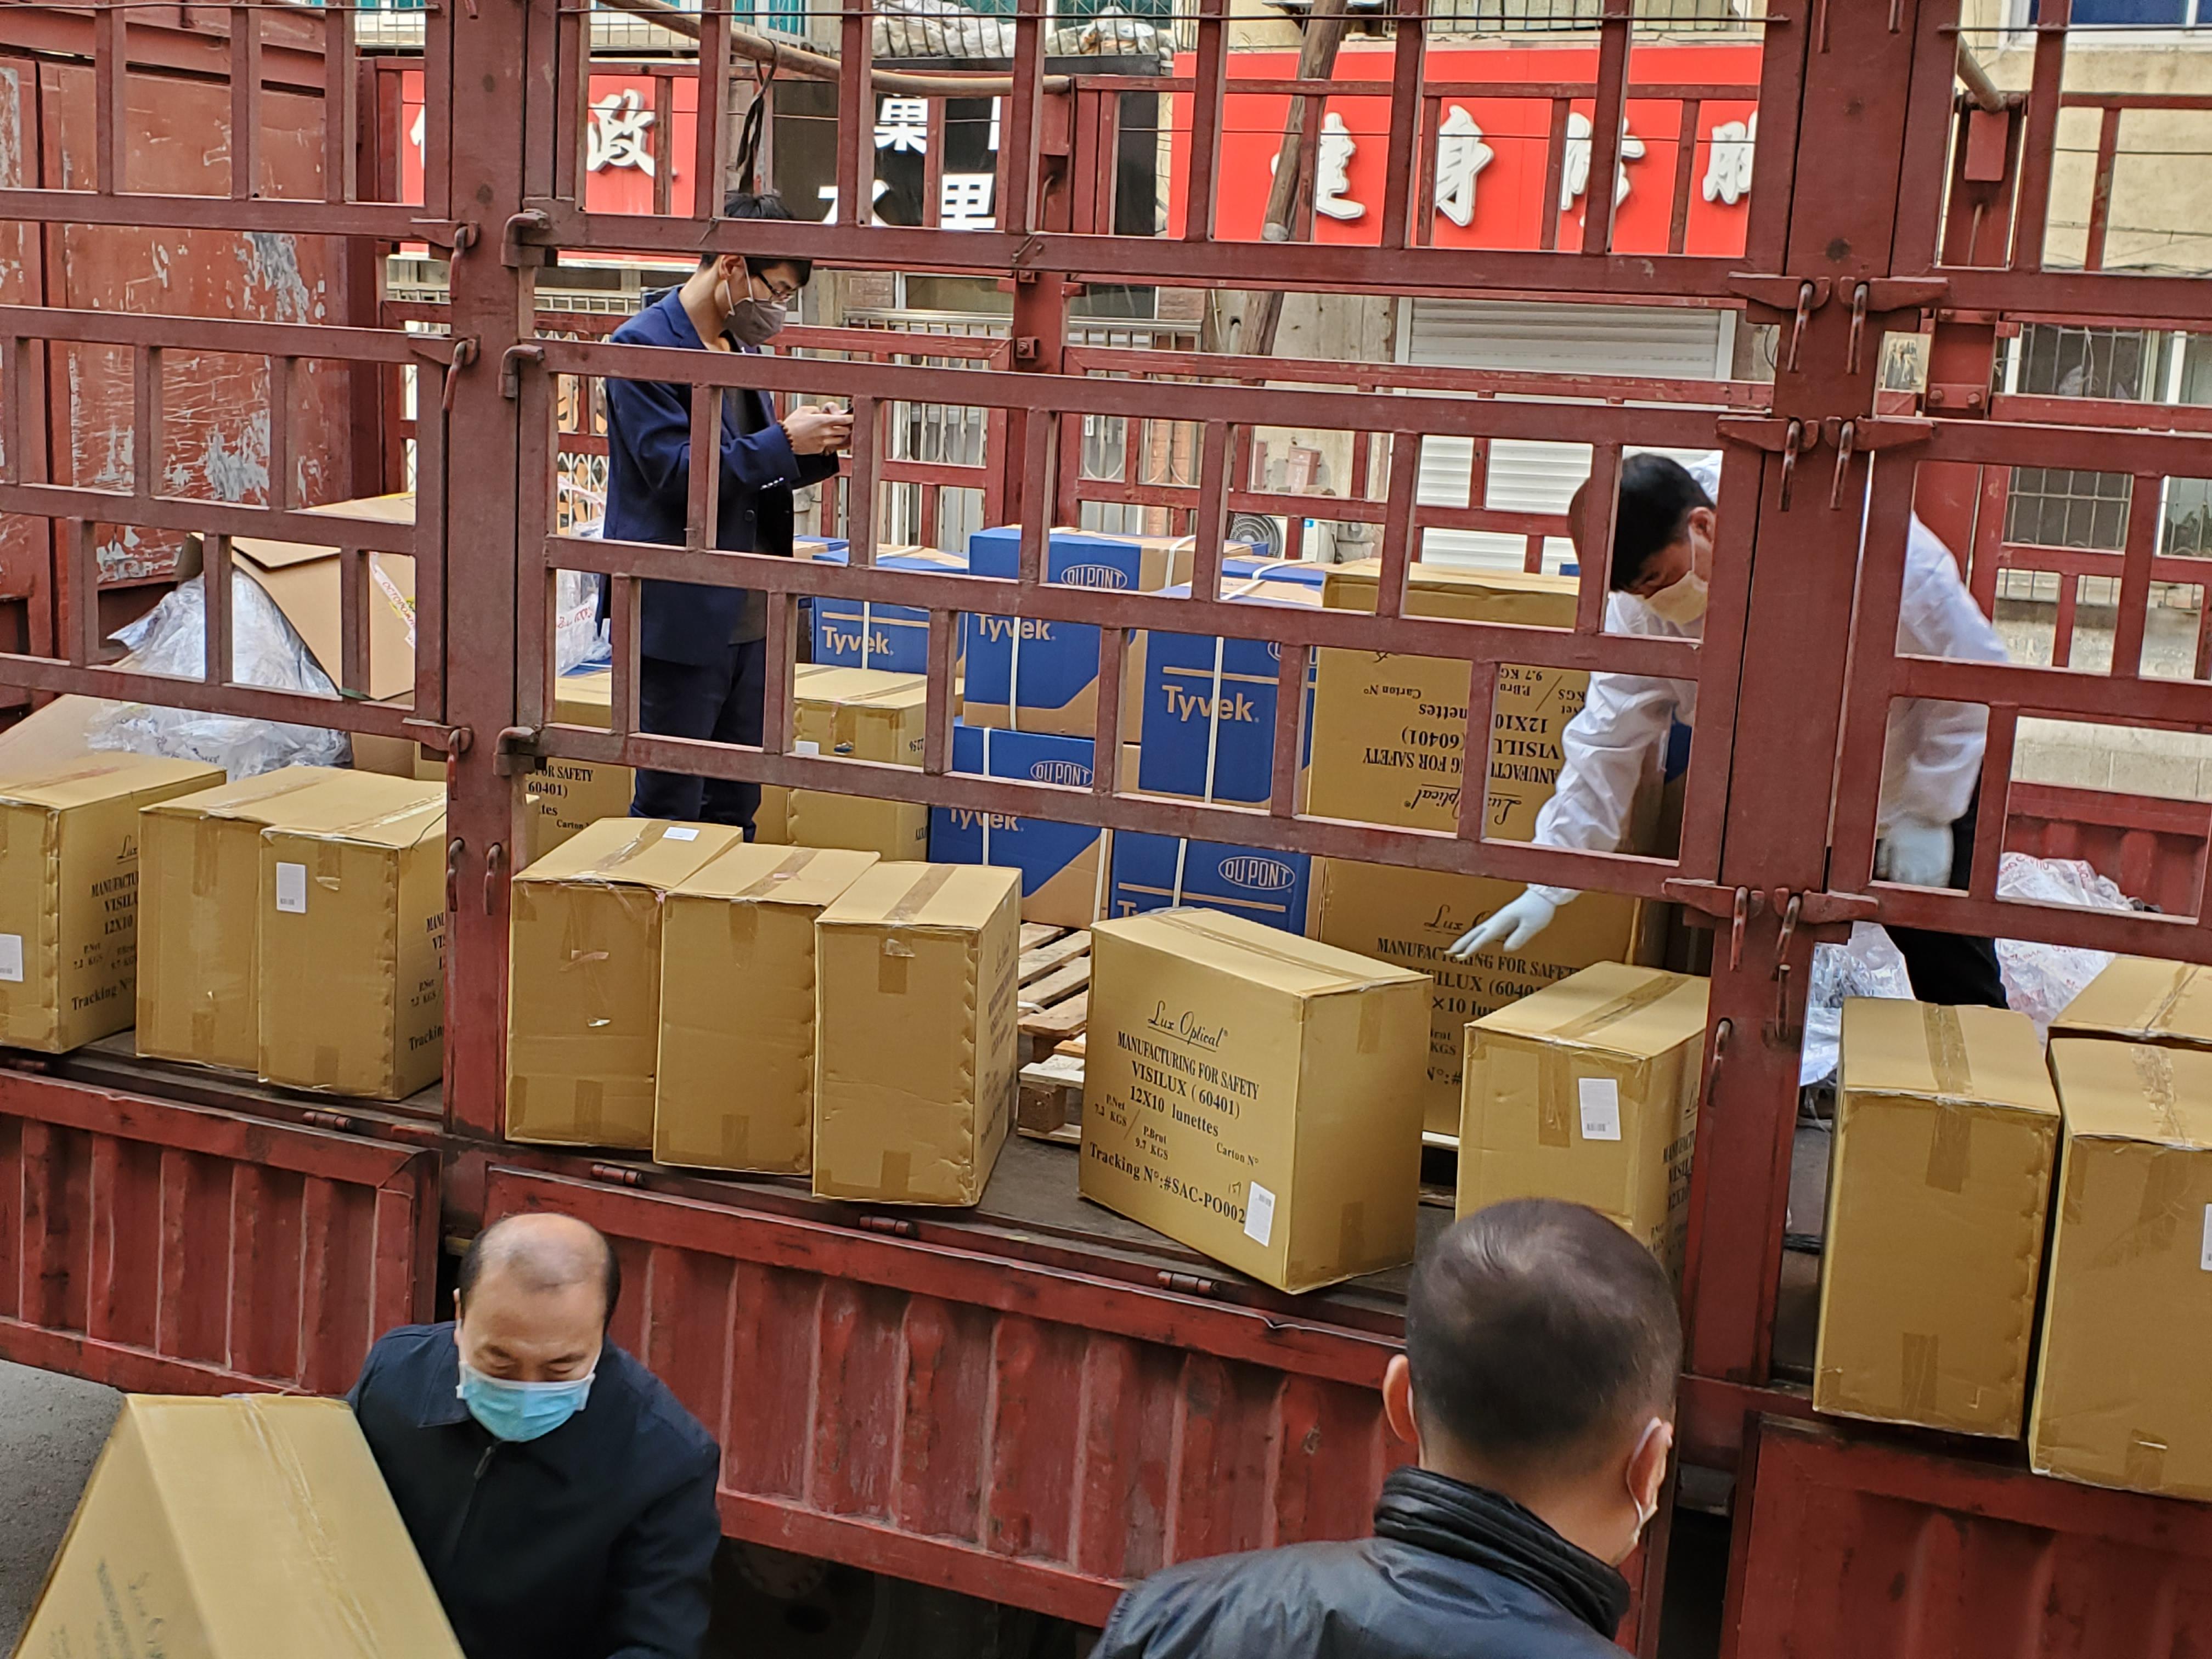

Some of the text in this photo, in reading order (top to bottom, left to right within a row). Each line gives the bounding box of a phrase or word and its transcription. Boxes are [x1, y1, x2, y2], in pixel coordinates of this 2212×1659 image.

[974, 613, 1051, 642] Tyvek
[821, 626, 889, 655] Tyvek
[1525, 670, 1542, 681] 9.7
[1382, 686, 1421, 699] Carton
[1500, 684, 1531, 696] P.Bru
[1162, 685, 1254, 722] Tyvek
[1419, 703, 1548, 734] 12X10 nettes
[1402, 726, 1465, 751] (60401)
[1363, 748, 1414, 768] SAFETY
[1419, 754, 1447, 772] FOR
[557, 766, 594, 782] SAFETY
[556, 819, 584, 830] Carton
[1424, 904, 1464, 930] Lux
[1498, 956, 1526, 975] FOR
[71, 985, 117, 1010] Tracking
[1148, 1000, 1174, 1030] Lux
[409, 1025, 444, 1051] Trackin
[1118, 1031, 1260, 1100] MANUFACTURING FOR SAFETY
[1132, 1060, 1187, 1097] VISILUX
[1110, 1111, 1127, 1127] KGS
[1130, 1085, 1219, 1137] 12X10 lunettes
[1090, 1141, 1140, 1181] Tracking
[1150, 1144, 1169, 1160] KGS
[1216, 1142, 1245, 1163] Carton
